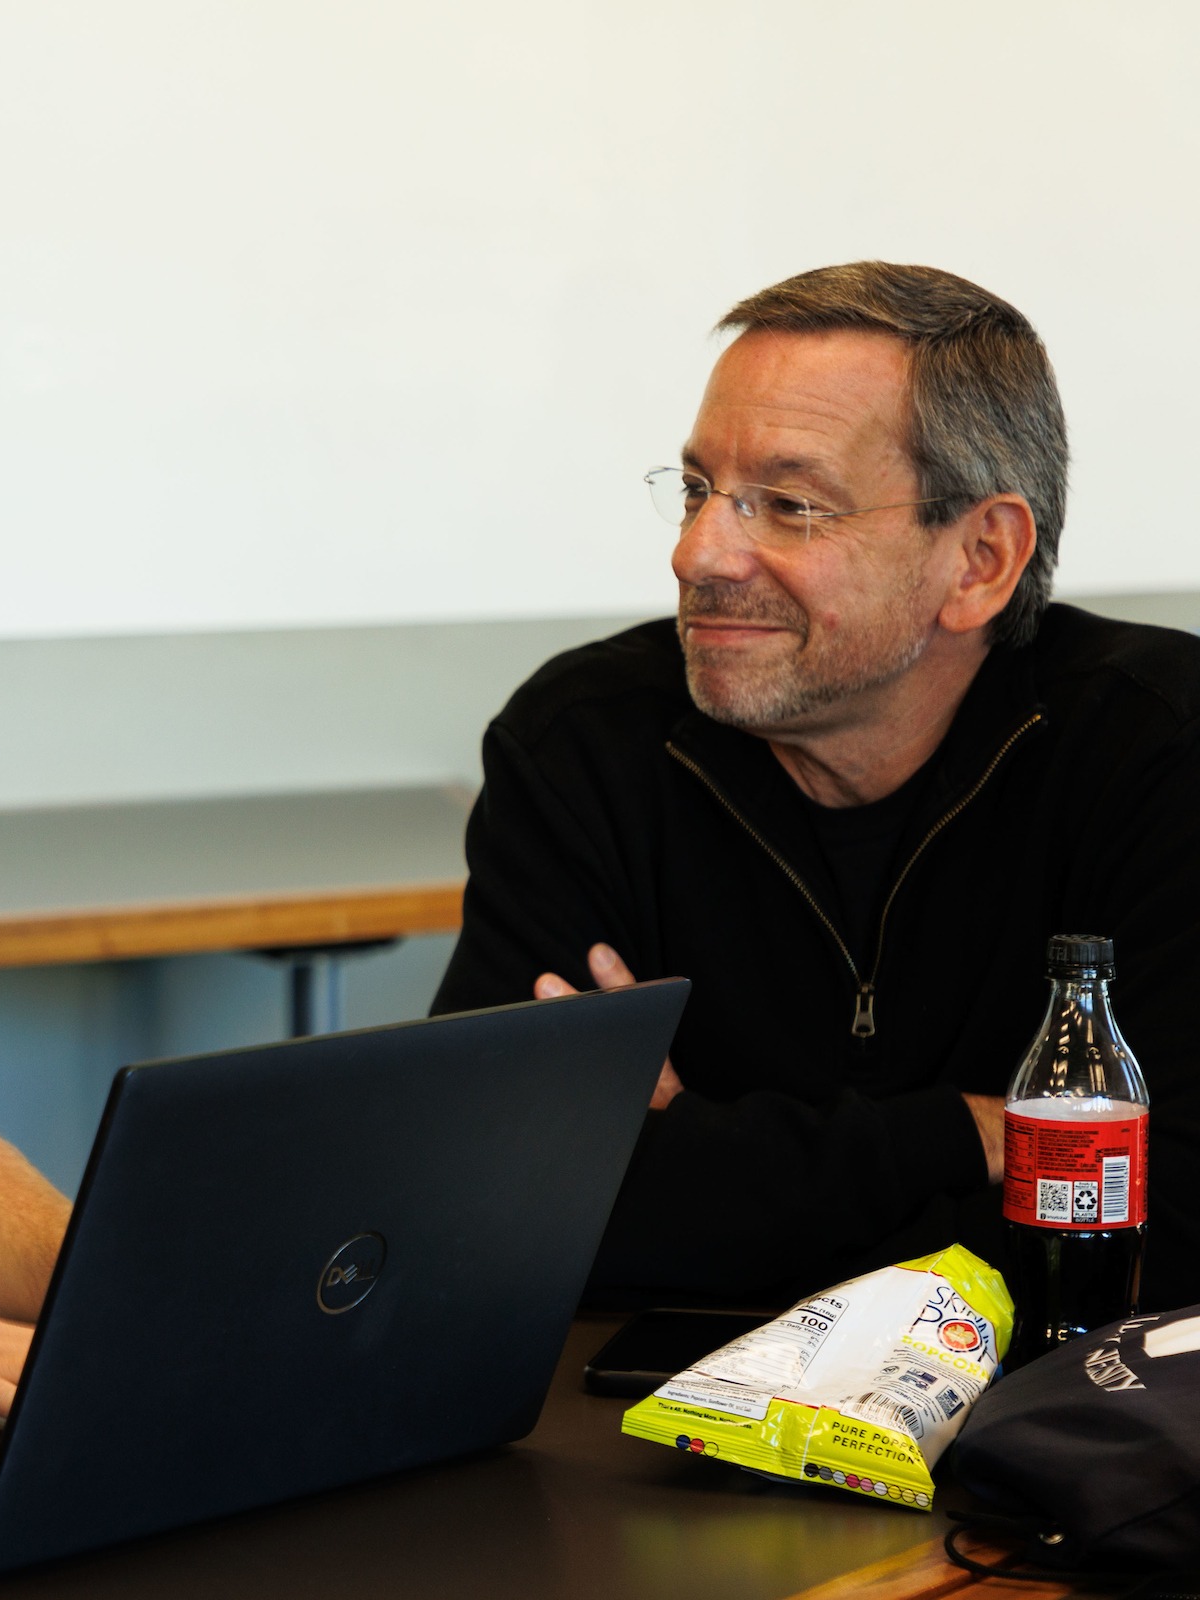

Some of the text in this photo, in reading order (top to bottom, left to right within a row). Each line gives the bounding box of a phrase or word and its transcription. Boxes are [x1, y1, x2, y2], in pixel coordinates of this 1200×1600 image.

[800, 1315, 828, 1331] 100
[683, 1408, 703, 1418] Nothing
[832, 1421, 867, 1438] PURE
